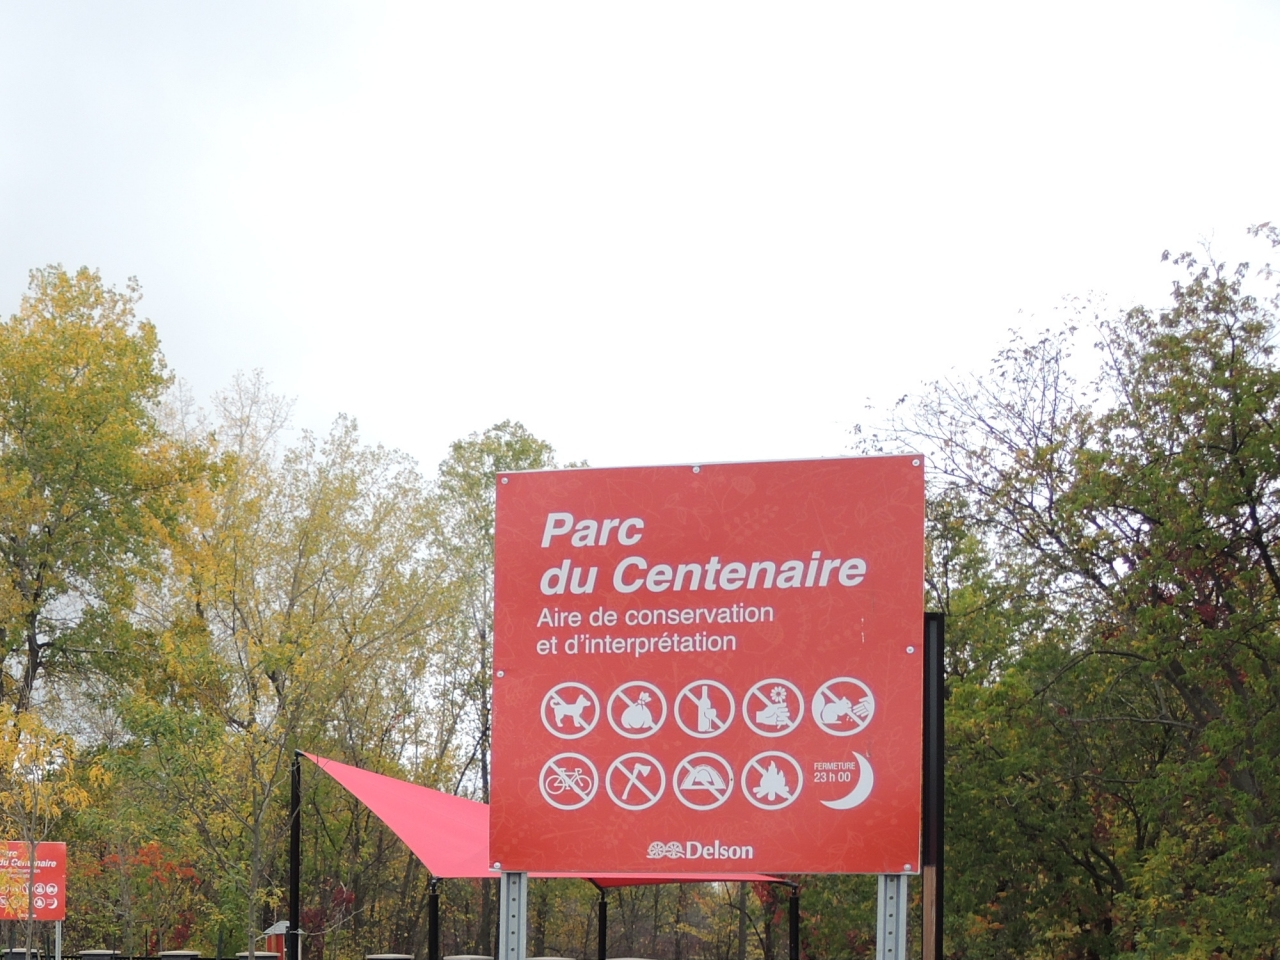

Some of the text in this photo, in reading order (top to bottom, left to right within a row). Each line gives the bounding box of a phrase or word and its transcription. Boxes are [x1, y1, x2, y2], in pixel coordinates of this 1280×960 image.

[540, 512, 645, 548] Parc
[539, 551, 867, 595] du Centenaire
[536, 602, 775, 628] Aire de conservation
[536, 631, 737, 658] et d'interprétation
[813, 761, 856, 771] FERMETURE
[813, 771, 851, 783] 23 h 00
[685, 840, 754, 860] Delson
